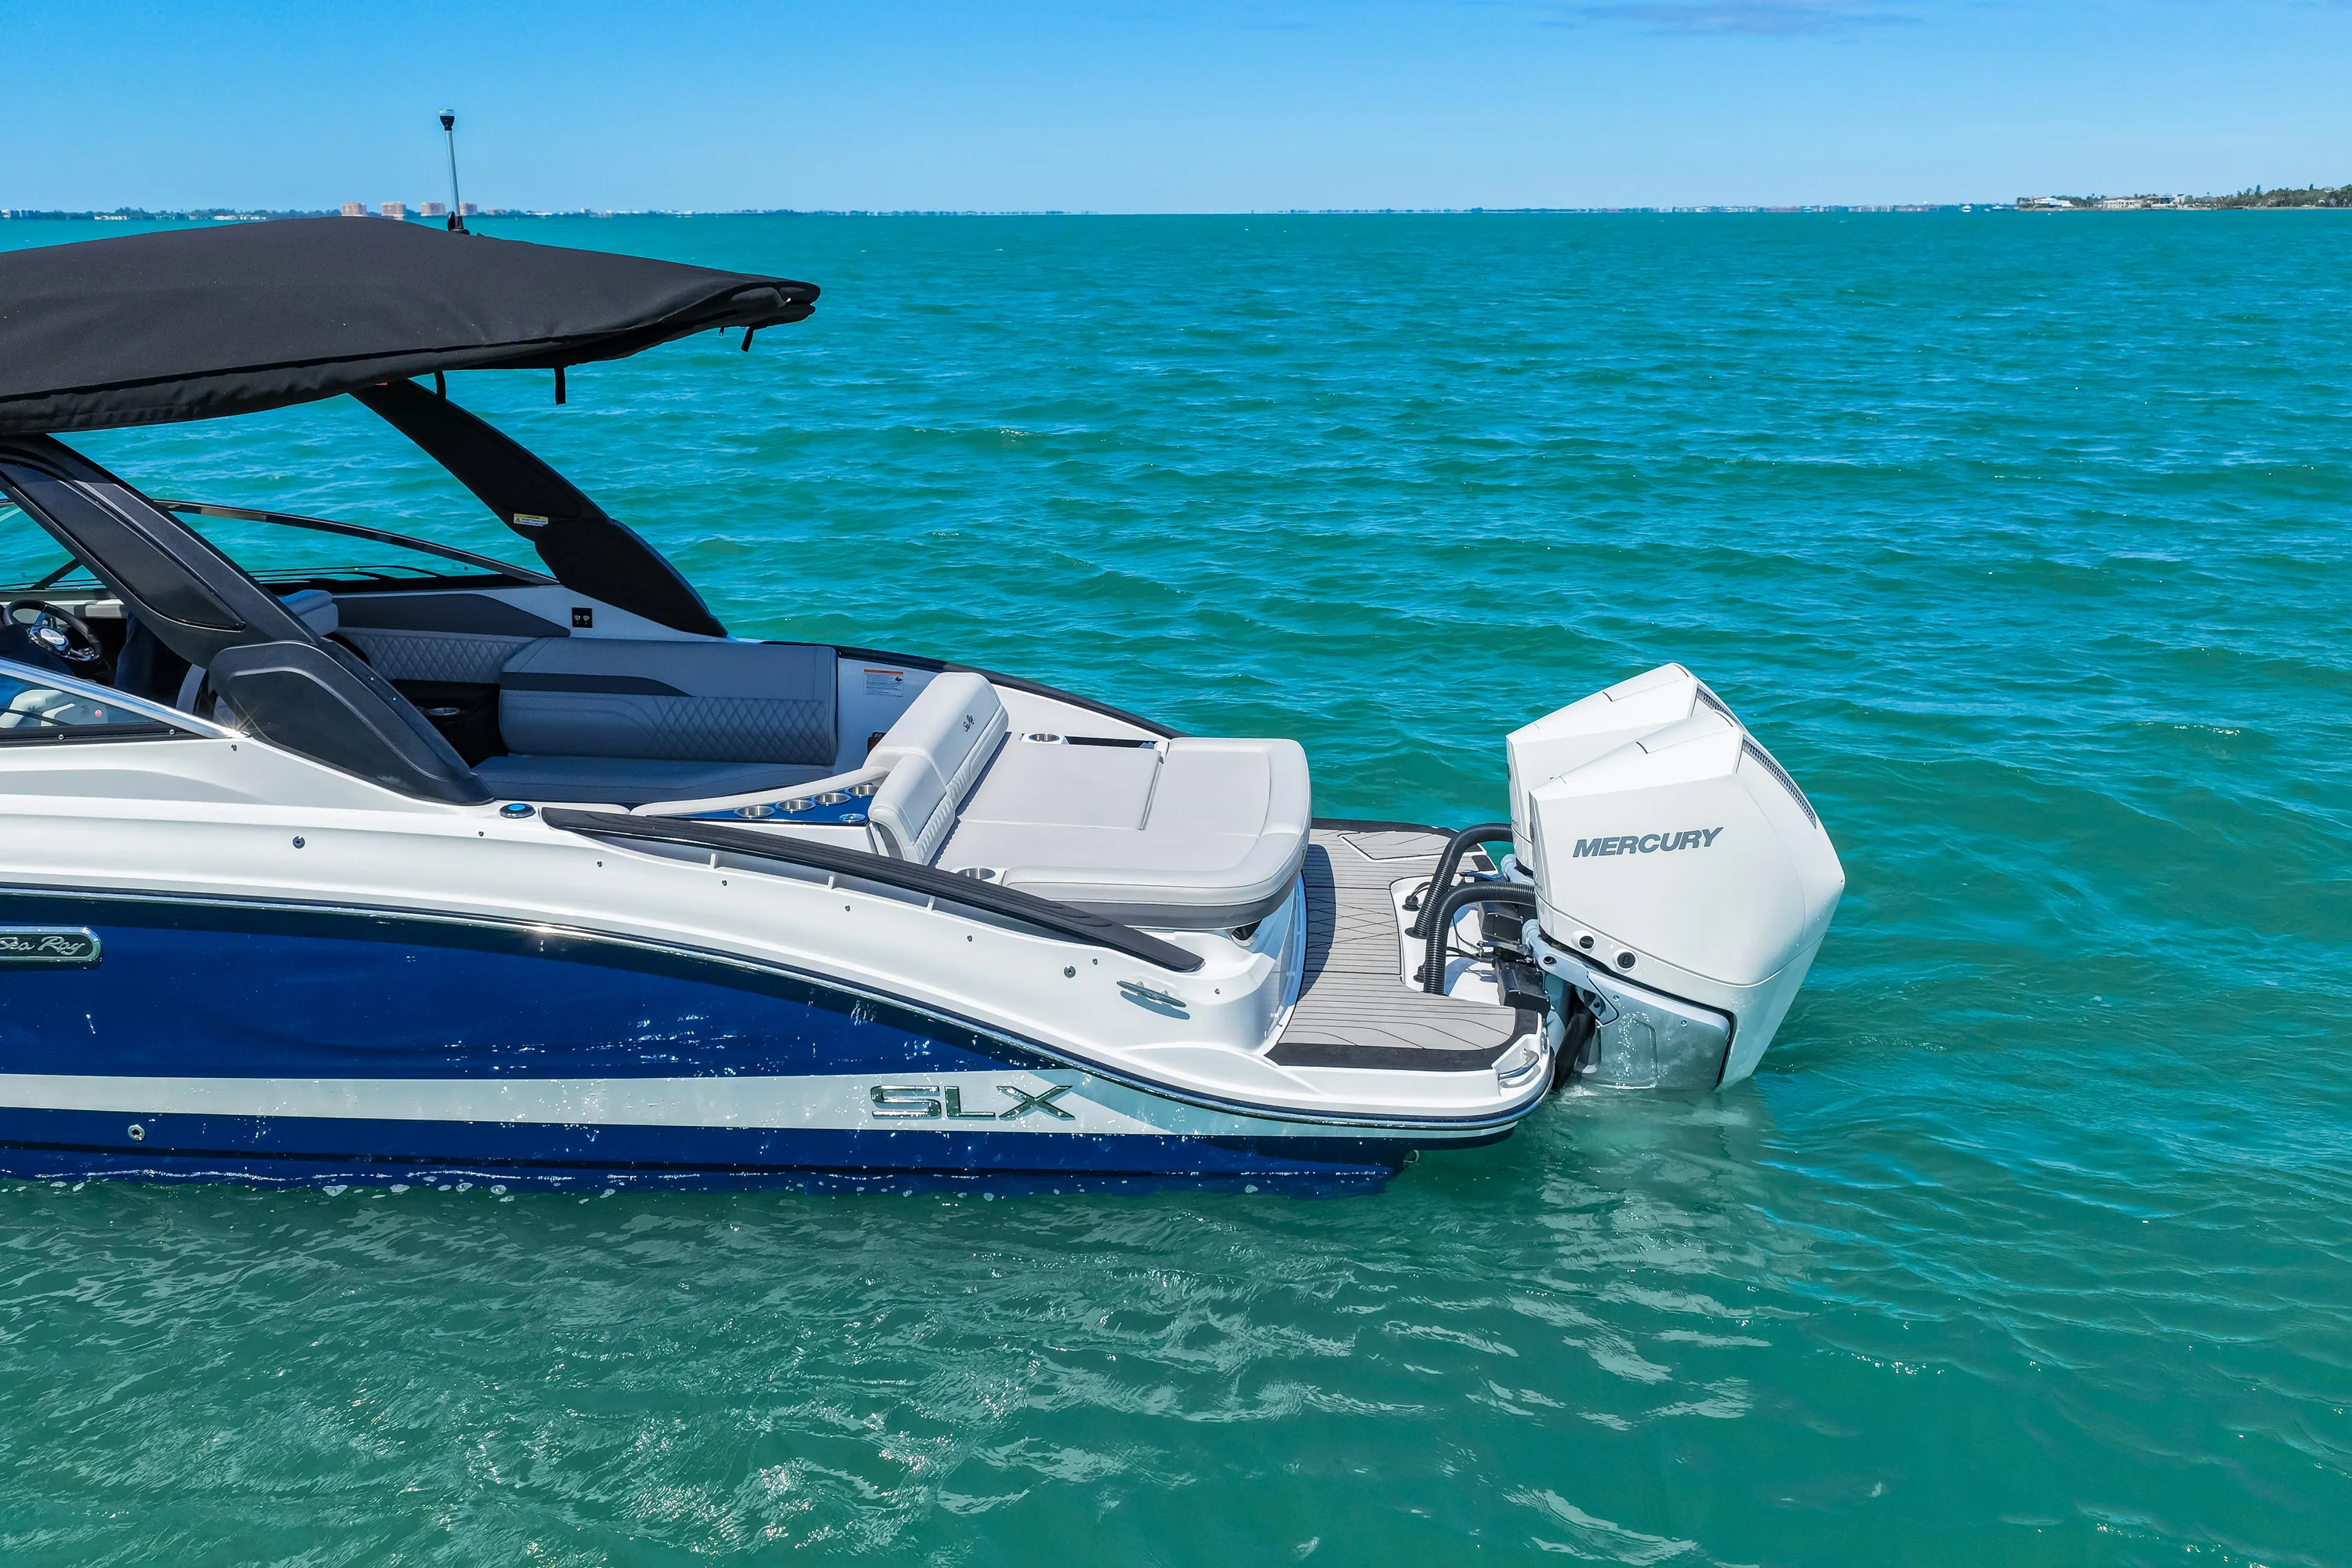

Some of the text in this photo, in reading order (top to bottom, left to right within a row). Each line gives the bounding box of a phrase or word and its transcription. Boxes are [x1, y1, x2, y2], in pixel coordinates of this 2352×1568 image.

[1573, 826, 1724, 858] MERCURY
[0, 936, 86, 956] Sea Ray
[870, 1085, 1076, 1119] SLX
